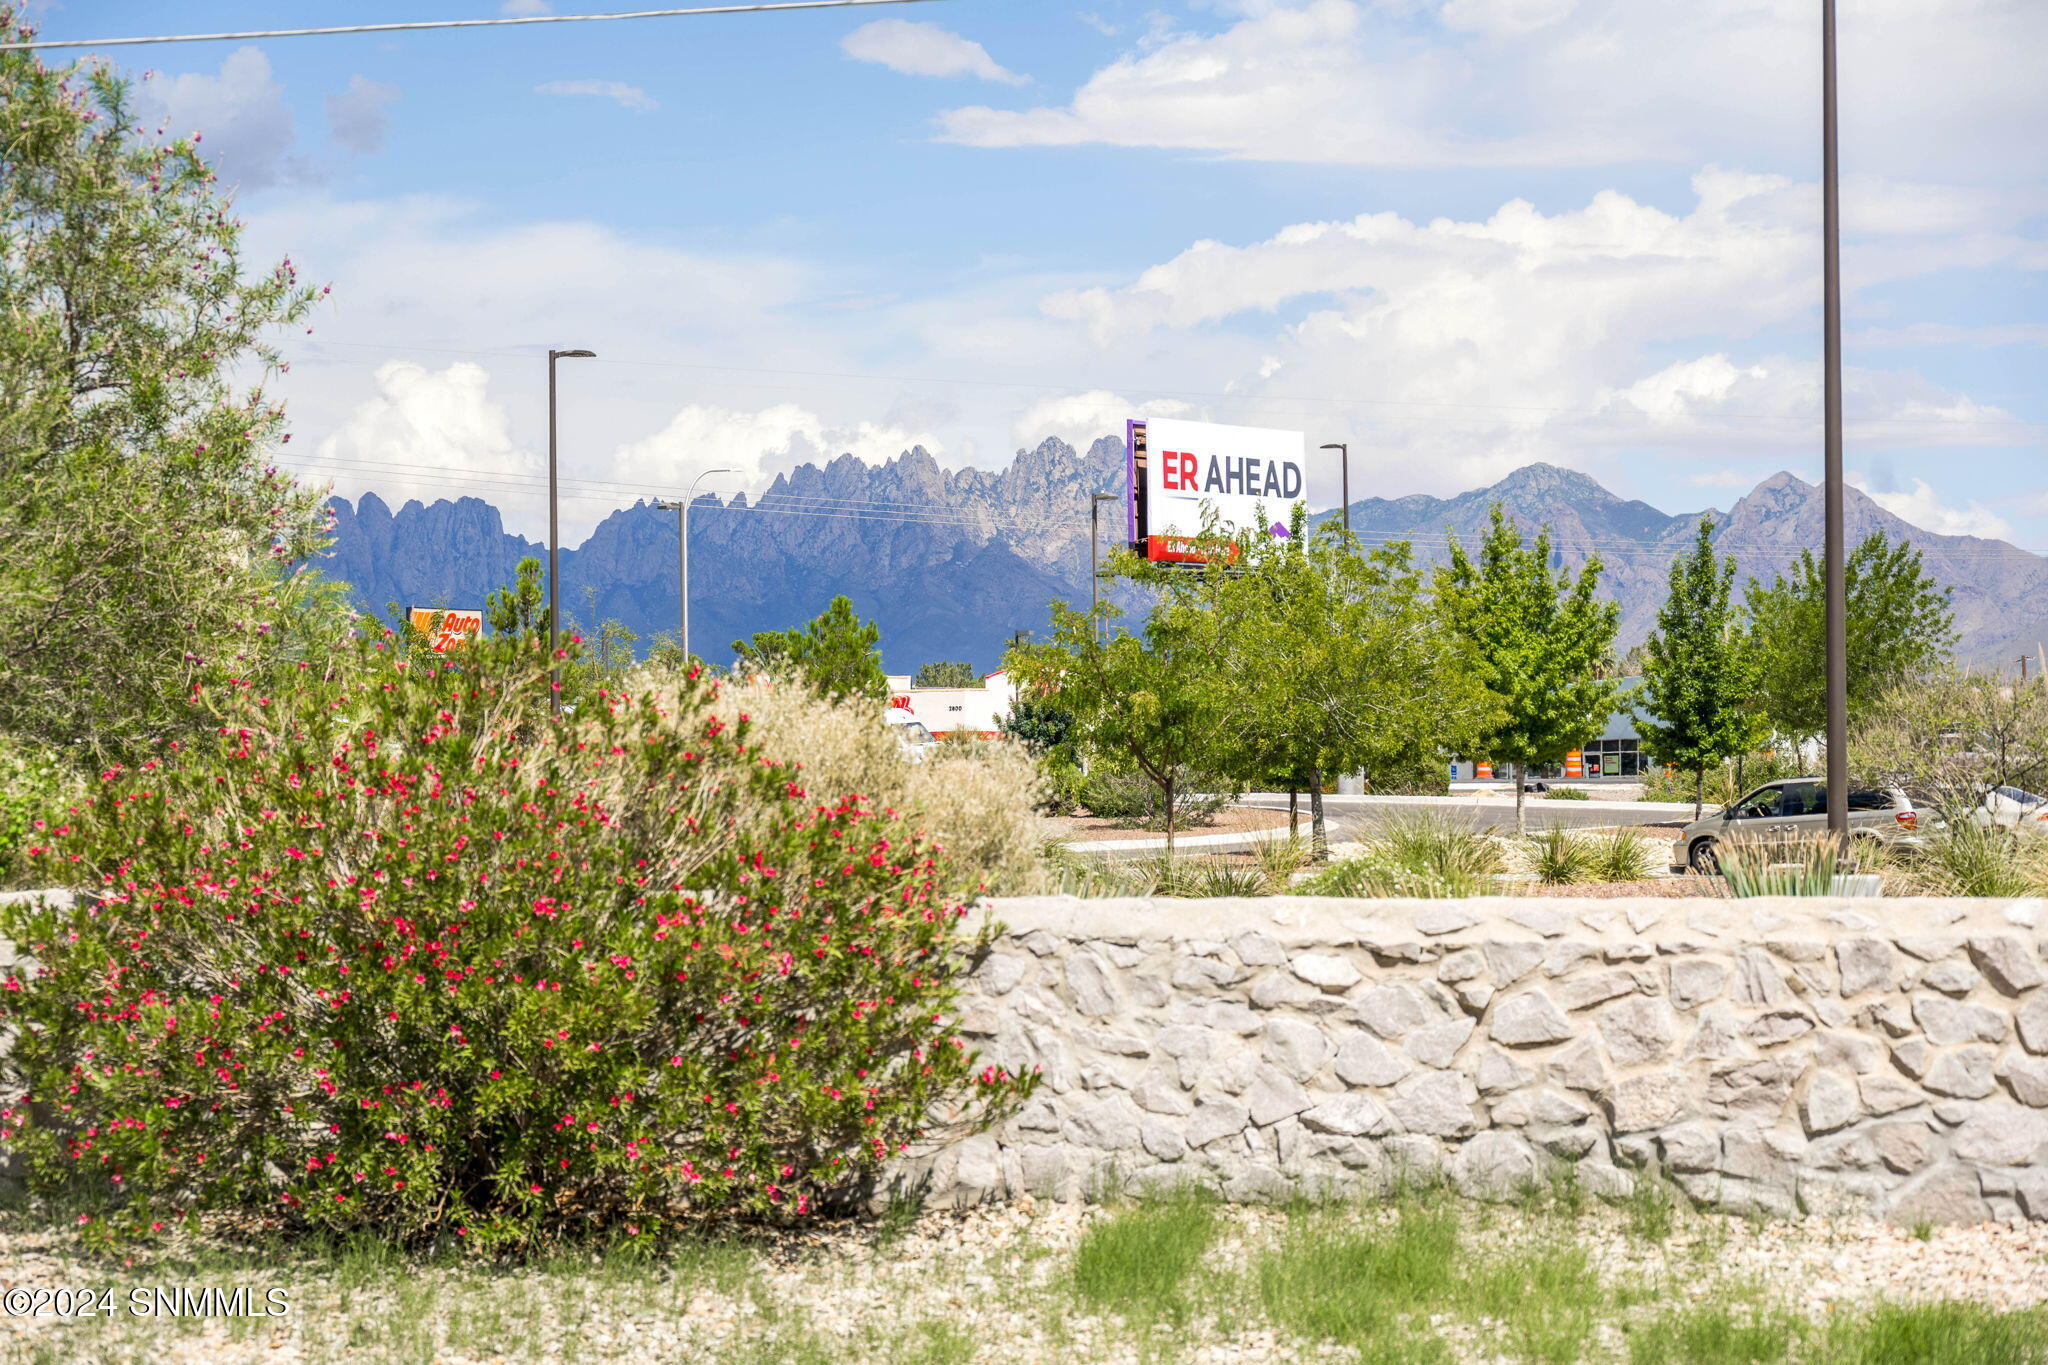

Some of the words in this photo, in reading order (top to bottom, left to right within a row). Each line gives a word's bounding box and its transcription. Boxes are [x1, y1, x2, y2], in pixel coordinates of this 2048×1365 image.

[1162, 450, 1199, 492] ER
[1204, 454, 1302, 499] AHEAD
[441, 612, 481, 633] Auto
[433, 633, 467, 653] Zon
